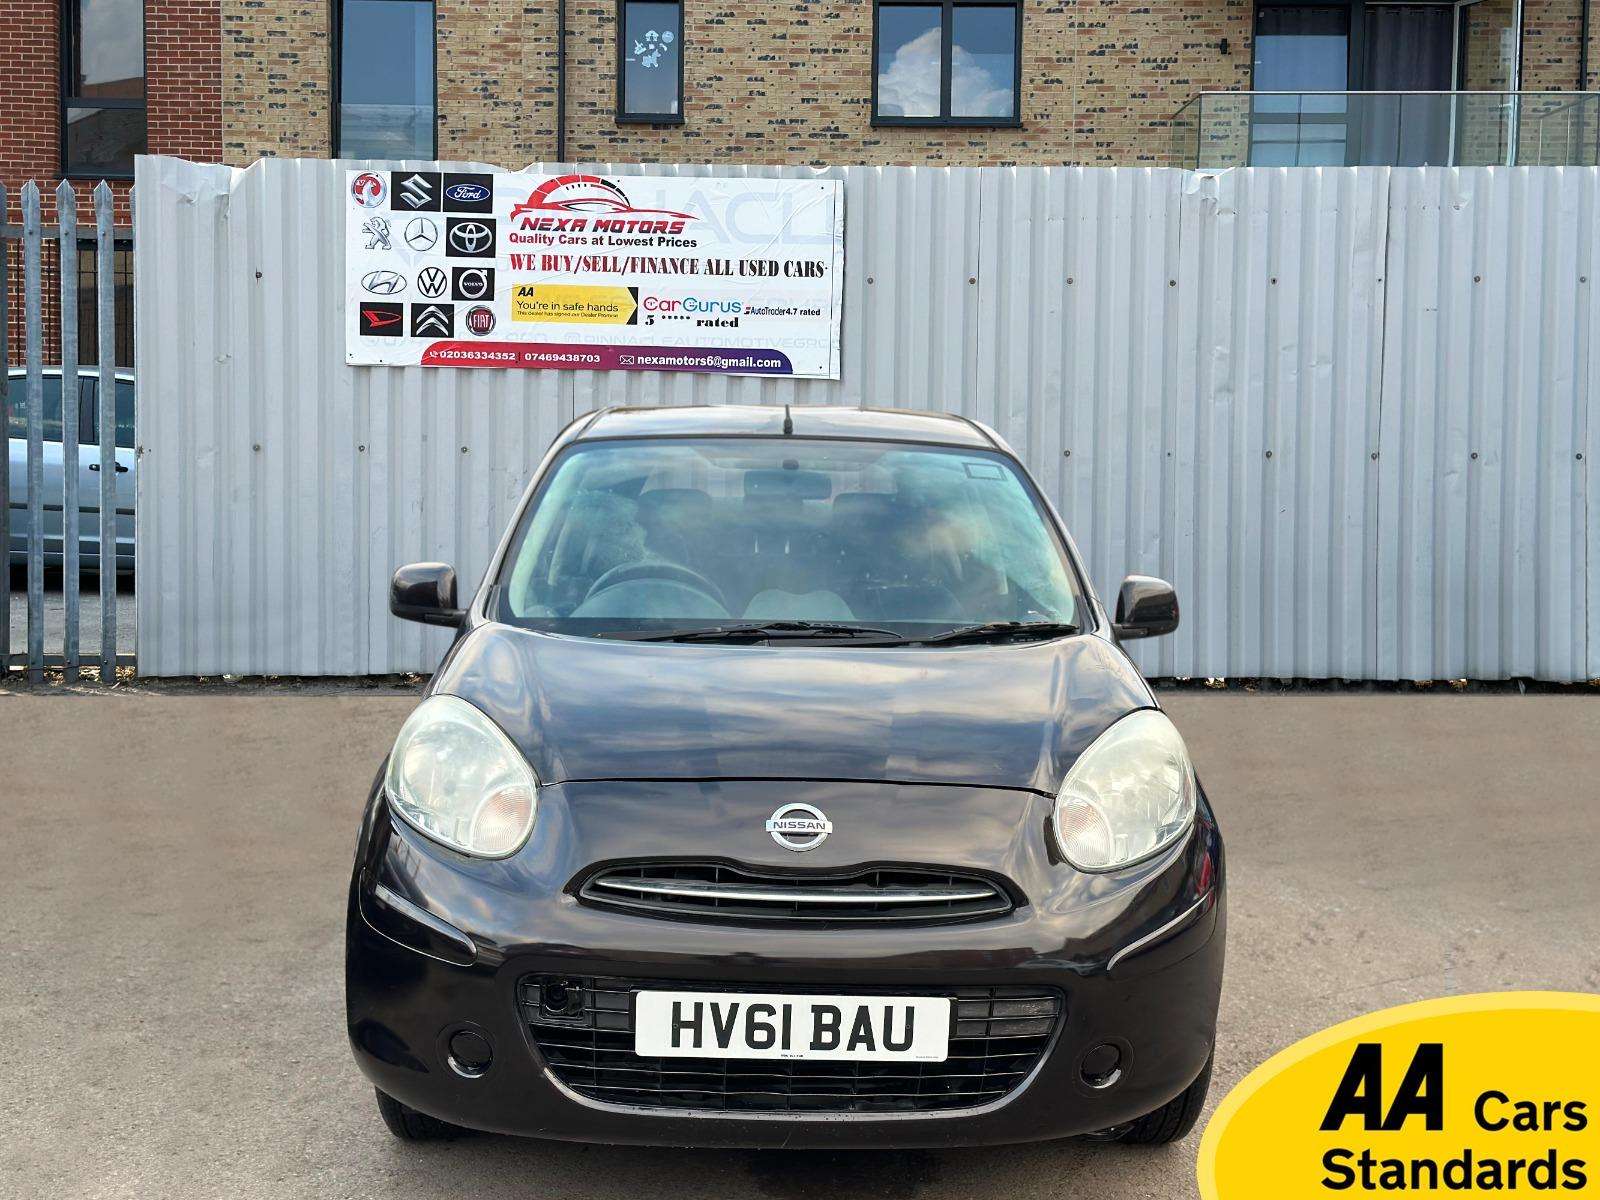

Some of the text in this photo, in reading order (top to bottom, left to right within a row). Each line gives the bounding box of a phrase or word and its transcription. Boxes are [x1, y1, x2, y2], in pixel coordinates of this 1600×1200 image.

[454, 186, 481, 199] Ford
[520, 217, 686, 234] NEXA MOTORS
[509, 232, 698, 248] Quality Cars at Lowest Prices
[509, 253, 825, 278] WE BUY/SELL/FINANCE ALL USED CARS
[518, 287, 534, 297] AA
[517, 300, 619, 312] You're in safe hands
[643, 296, 742, 313] CarGurus
[799, 308, 821, 316] rated
[473, 315, 489, 328] FIAT
[645, 314, 739, 328] 5 rated
[637, 355, 782, 369] nexamotors6@gmail.com
[773, 821, 826, 830] NISSAN
[671, 1001, 915, 1052] HV61 BAU
